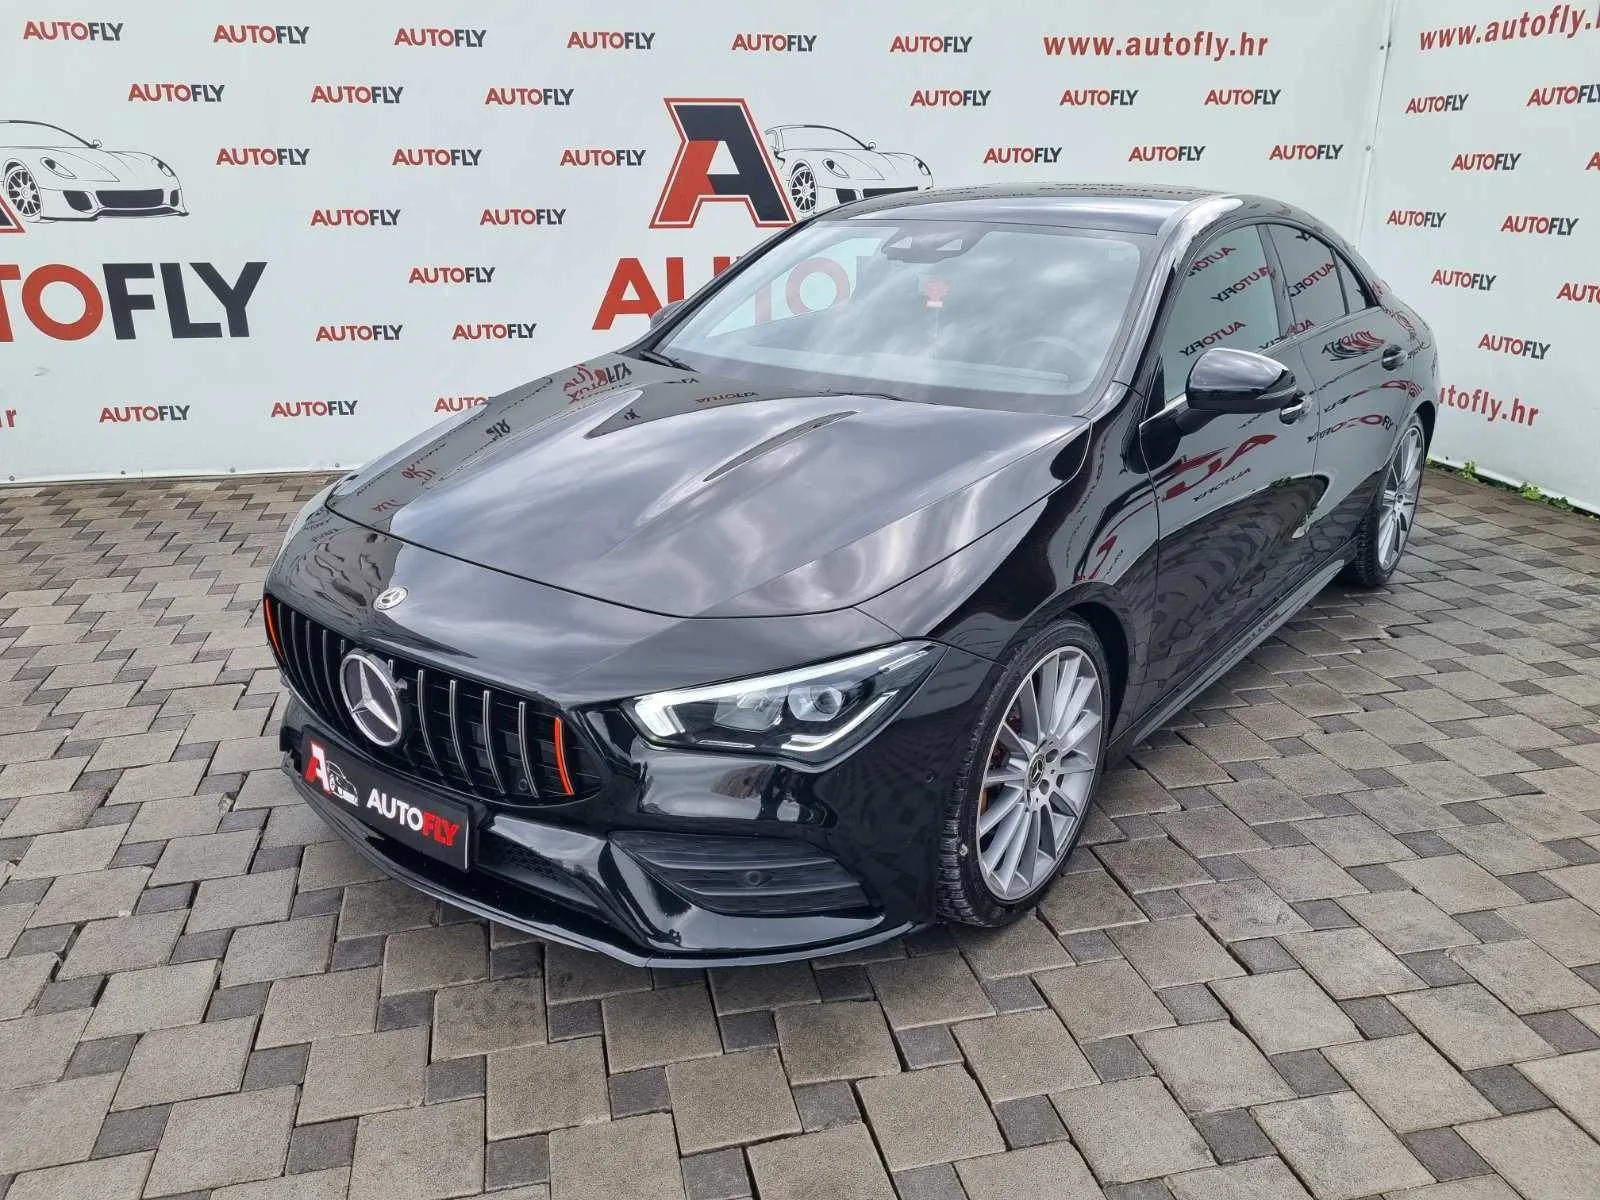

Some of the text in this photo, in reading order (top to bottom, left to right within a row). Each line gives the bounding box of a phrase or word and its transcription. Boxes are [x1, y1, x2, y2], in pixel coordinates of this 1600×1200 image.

[24, 21, 123, 41] AUTOFLY
[213, 25, 309, 44] AUTOFLY
[394, 28, 486, 47] AUTOFLY
[567, 32, 655, 49] AUTOFLY
[732, 34, 817, 52] AUTOFLY
[890, 36, 972, 53] AUTOFLY
[1044, 31, 1268, 61] www.autofly.hr
[128, 84, 225, 102] AUTOFLY
[311, 86, 403, 104] AUTOFLY
[485, 88, 574, 106] AUTOFLY
[910, 90, 991, 106] AUTOFLY
[1060, 90, 1138, 106] AUTOFLY
[1204, 89, 1281, 105] AUTOFLY
[1406, 94, 1469, 114] AUTOFLY
[216, 148, 310, 165] AUTOFLY
[393, 149, 482, 166] AUTOFLY
[560, 150, 646, 166] AUTOFLY
[983, 147, 1062, 164] AUTOFLY
[1129, 146, 1205, 162] AUTOFLY
[1269, 144, 1343, 160] AUTOFLY
[1451, 153, 1521, 170] AUTOFLY
[311, 209, 401, 226] AUTOFLY
[480, 209, 566, 225] AUTOFLY
[1387, 210, 1446, 228] AUTOFLY
[1501, 216, 1579, 236] AUTOFLY
[409, 267, 495, 284] AUTOFLY
[1431, 270, 1496, 291] AUTOFLY
[316, 325, 403, 342] AUTOFLY
[453, 323, 537, 340] AUTOFLY
[1478, 334, 1550, 360] AUTOFLY
[99, 405, 190, 423] AUTOFLY
[271, 400, 358, 417] AUTOFLY
[367, 788, 459, 846] AUTOFLY
